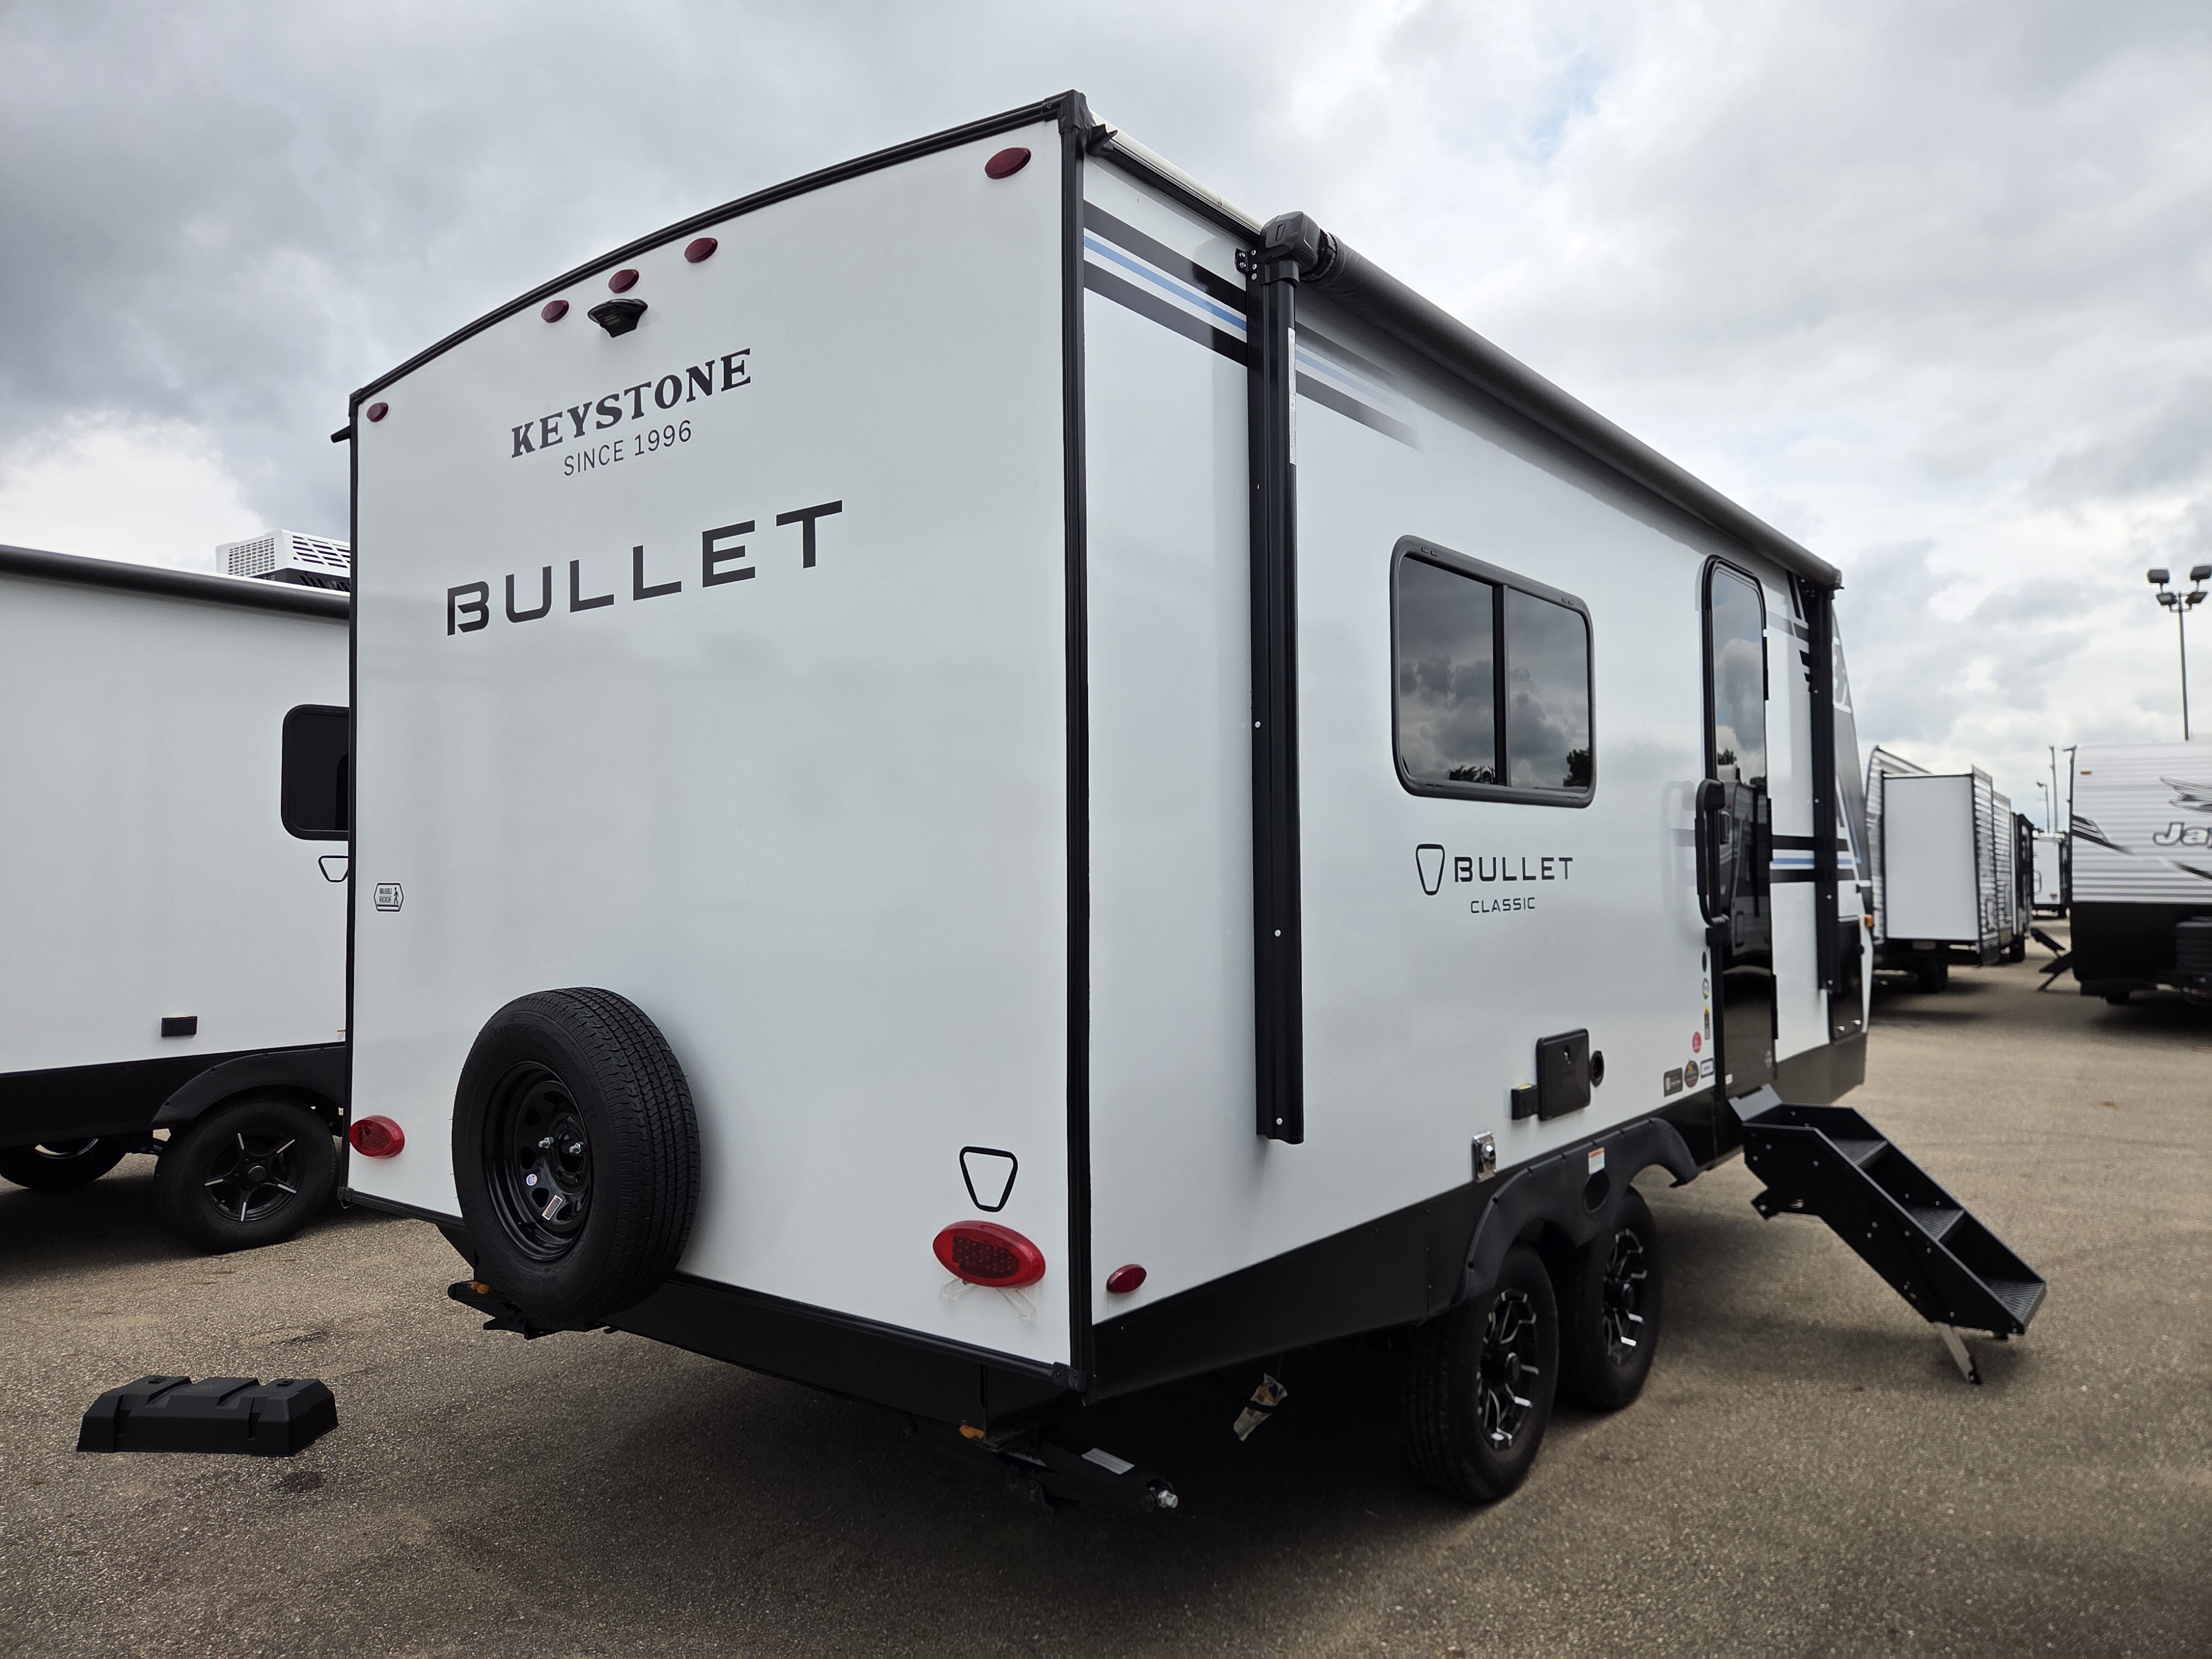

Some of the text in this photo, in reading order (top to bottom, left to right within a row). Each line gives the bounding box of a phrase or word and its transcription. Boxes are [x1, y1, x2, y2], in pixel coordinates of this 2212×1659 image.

[511, 347, 752, 458] KEYSTONE
[564, 420, 691, 476] SINCE 1996
[447, 499, 843, 636] BULLET
[2152, 821, 2212, 849] Ja
[1454, 856, 1573, 883] BULLET
[1470, 896, 1536, 914] CLASSIC
